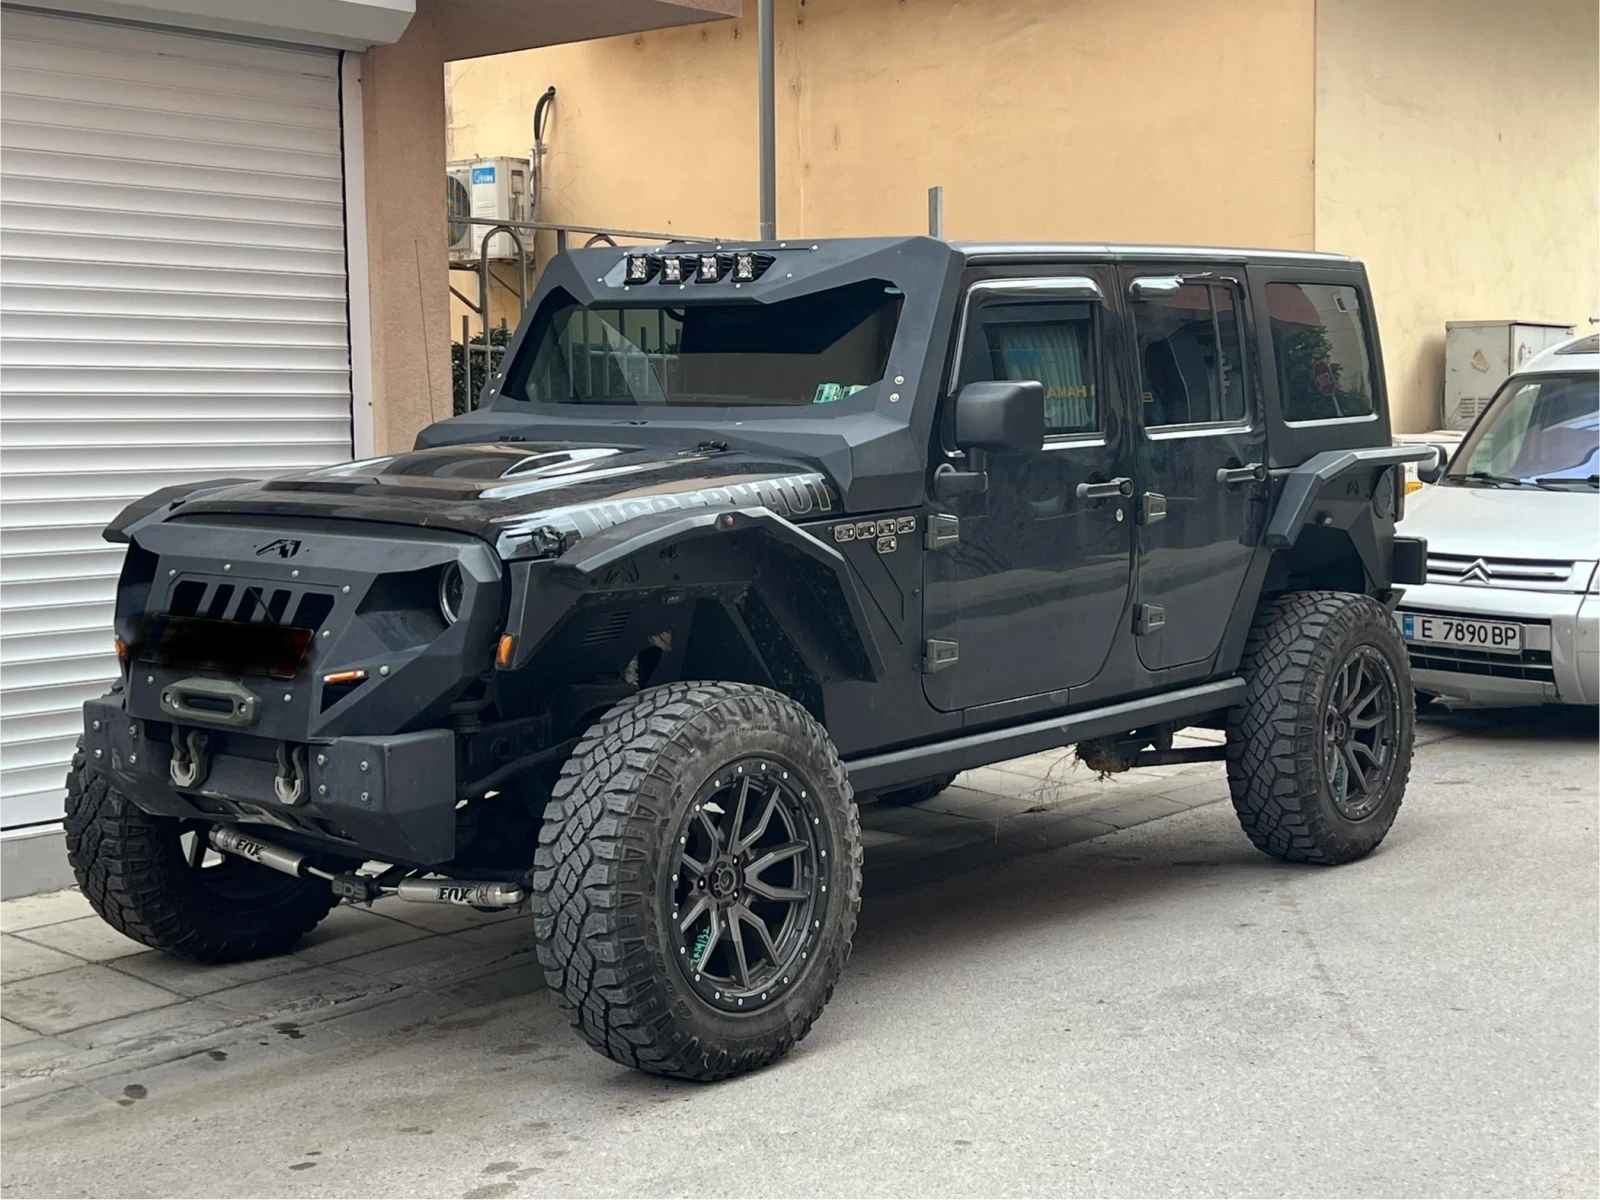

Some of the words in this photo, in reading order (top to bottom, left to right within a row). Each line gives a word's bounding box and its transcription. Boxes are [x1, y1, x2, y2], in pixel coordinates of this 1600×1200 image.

[1421, 619, 1433, 639] E
[1443, 621, 1488, 644] 7890
[1491, 626, 1517, 646] BP
[234, 837, 266, 858] FOX
[438, 886, 474, 902] FOX
